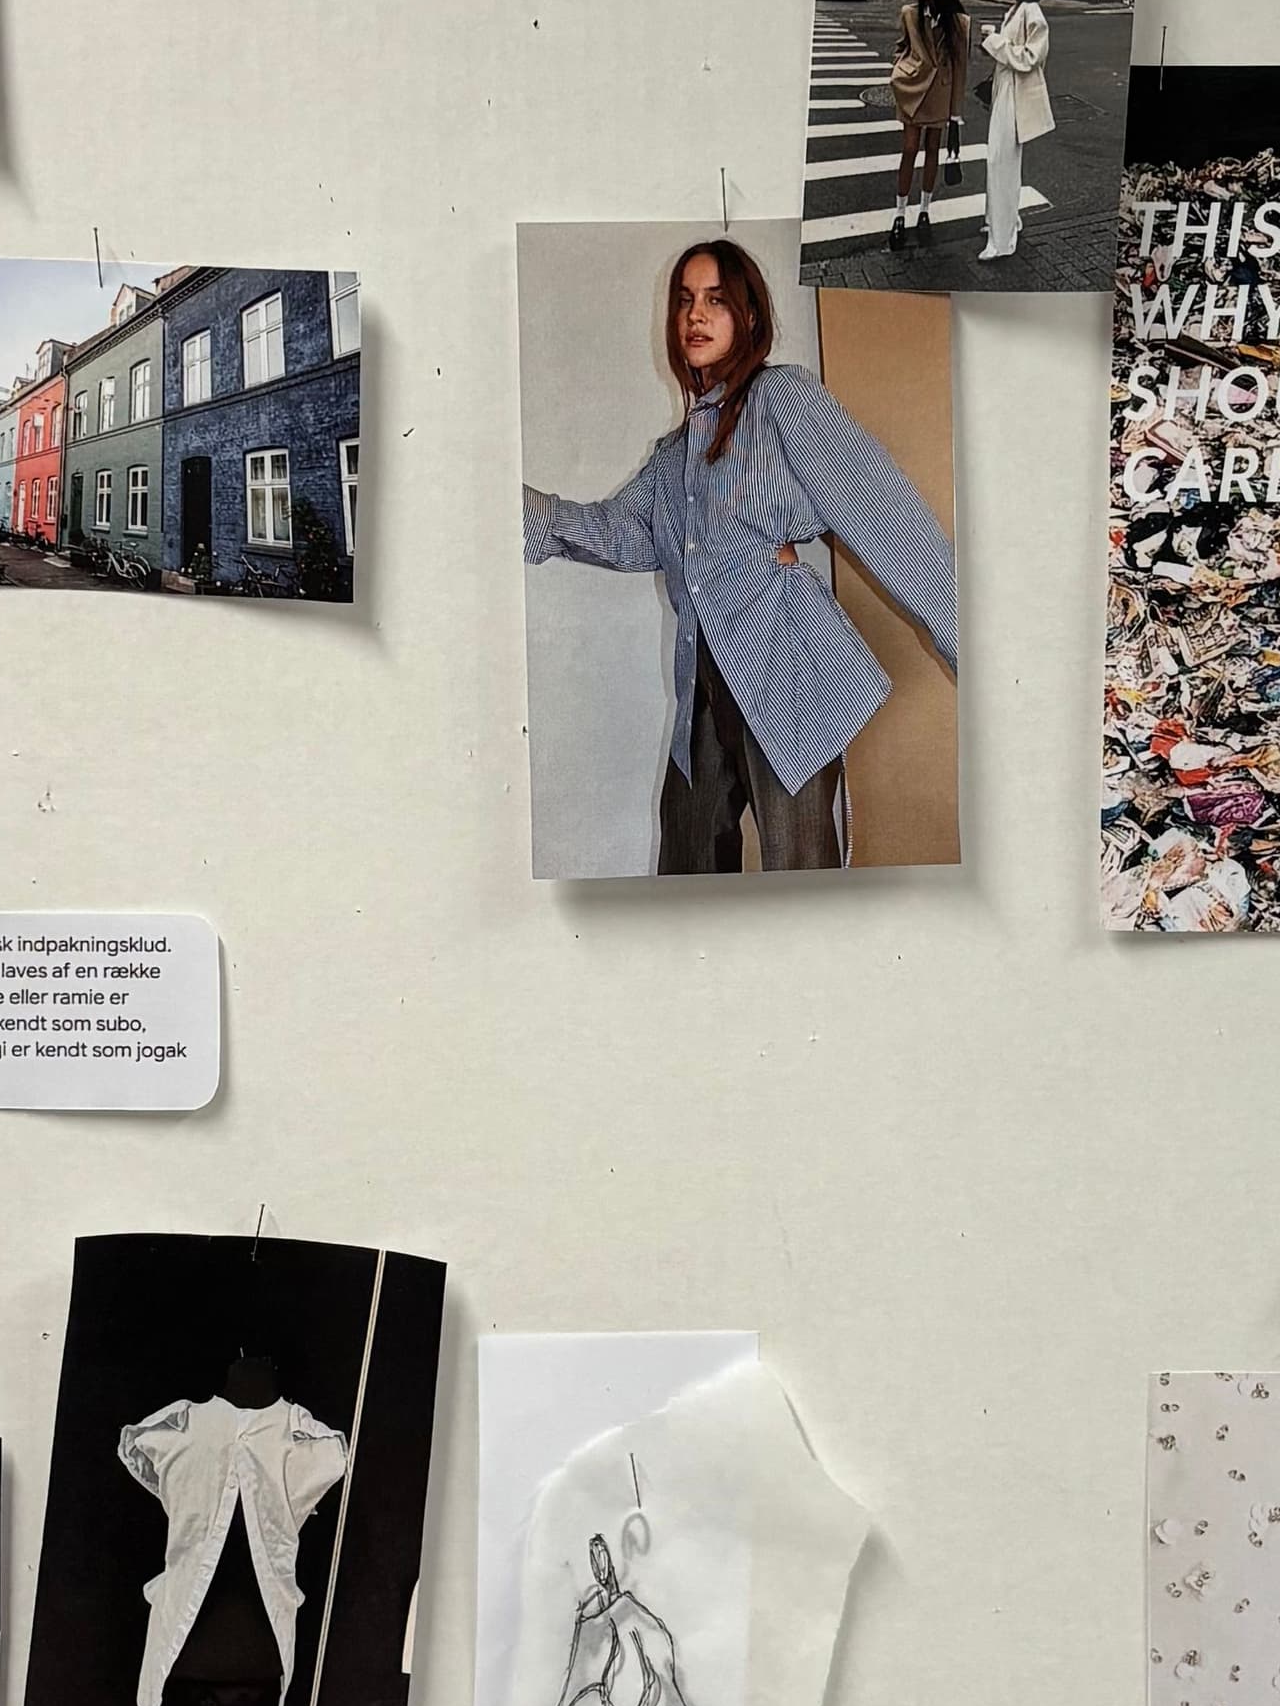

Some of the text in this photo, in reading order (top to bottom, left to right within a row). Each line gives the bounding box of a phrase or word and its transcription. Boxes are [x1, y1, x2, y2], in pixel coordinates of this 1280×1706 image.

[17, 935, 172, 958] indpakningsklud.
[1, 962, 49, 979] laves
[51, 962, 72, 979] af
[75, 966, 99, 980] en
[103, 962, 162, 980] række
[9, 988, 50, 1006] eller
[53, 988, 106, 1006] ramie
[109, 992, 130, 1006] er
[51, 1019, 92, 1032] som
[96, 1015, 147, 1034] subo,
